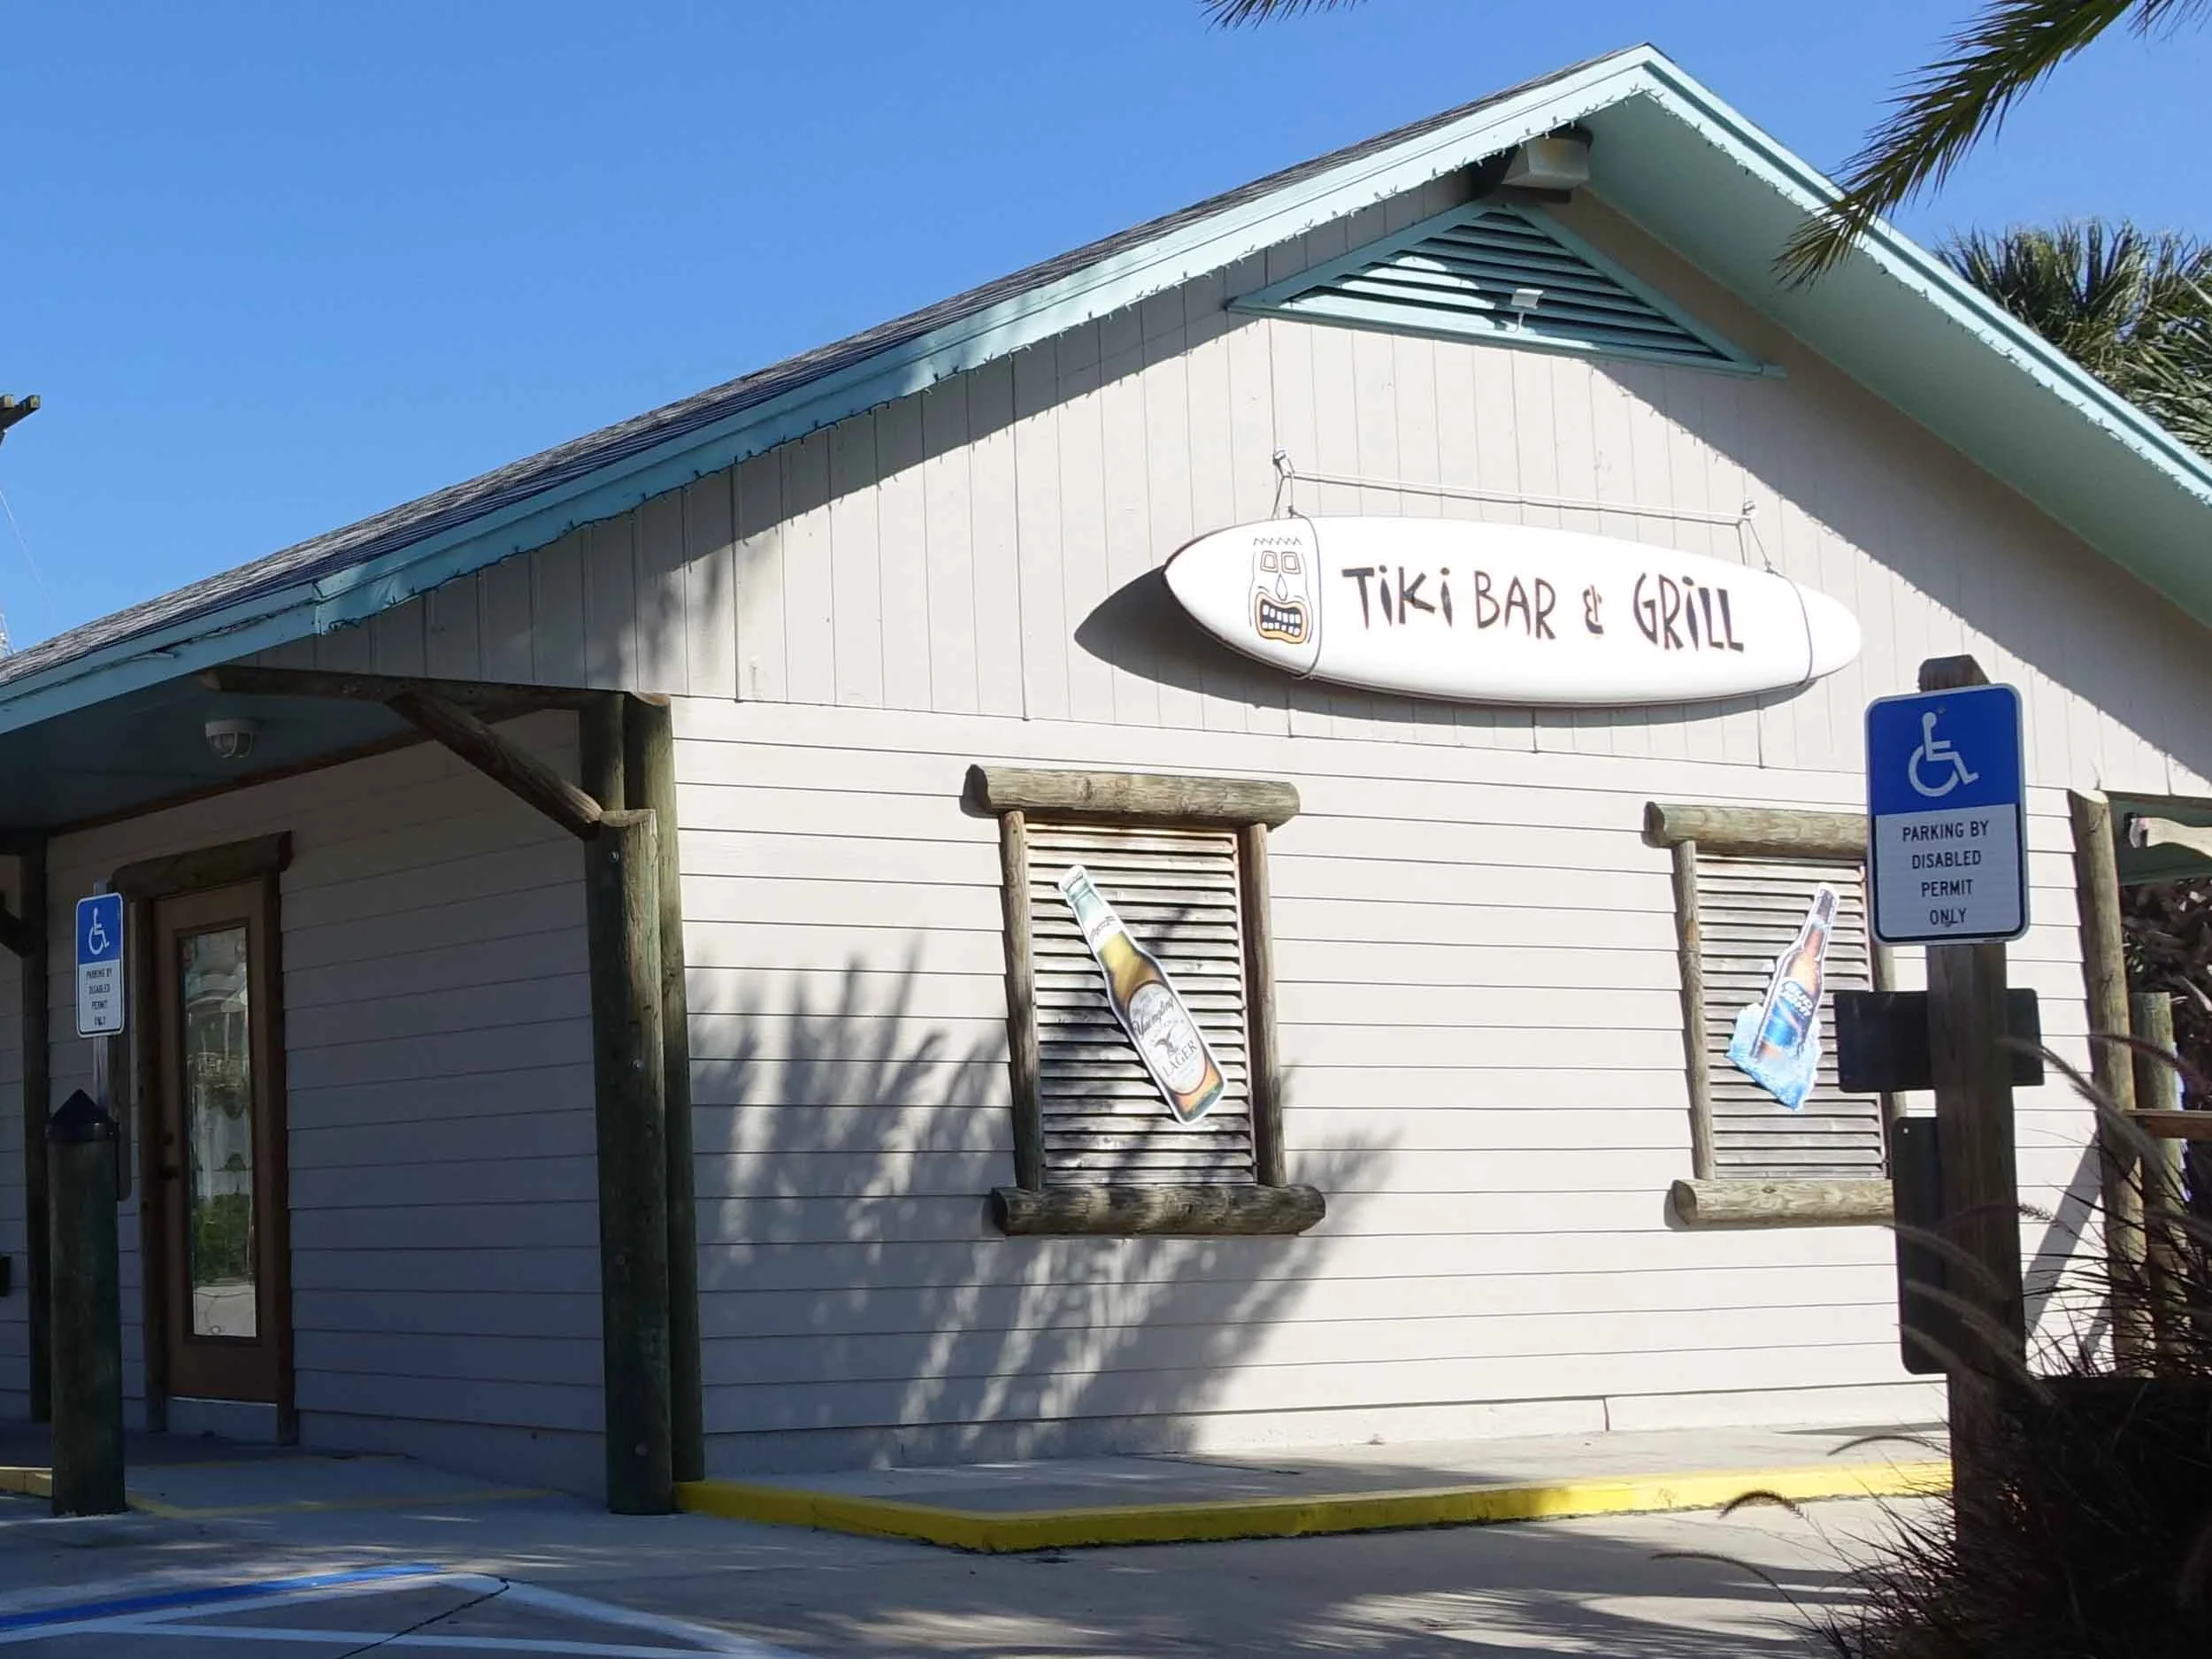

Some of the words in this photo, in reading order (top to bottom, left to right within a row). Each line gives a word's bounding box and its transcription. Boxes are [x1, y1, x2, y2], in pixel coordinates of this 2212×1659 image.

[1474, 571, 1557, 640] BAR
[1583, 585, 1605, 636] &
[1902, 822, 1963, 842] PARKING
[1970, 820, 1990, 837] BY
[1911, 850, 1982, 870] DISABLED
[1921, 879, 1974, 898] PERMIT
[1930, 909, 1967, 926] ONLY
[1162, 1039, 1198, 1078] LAGER
